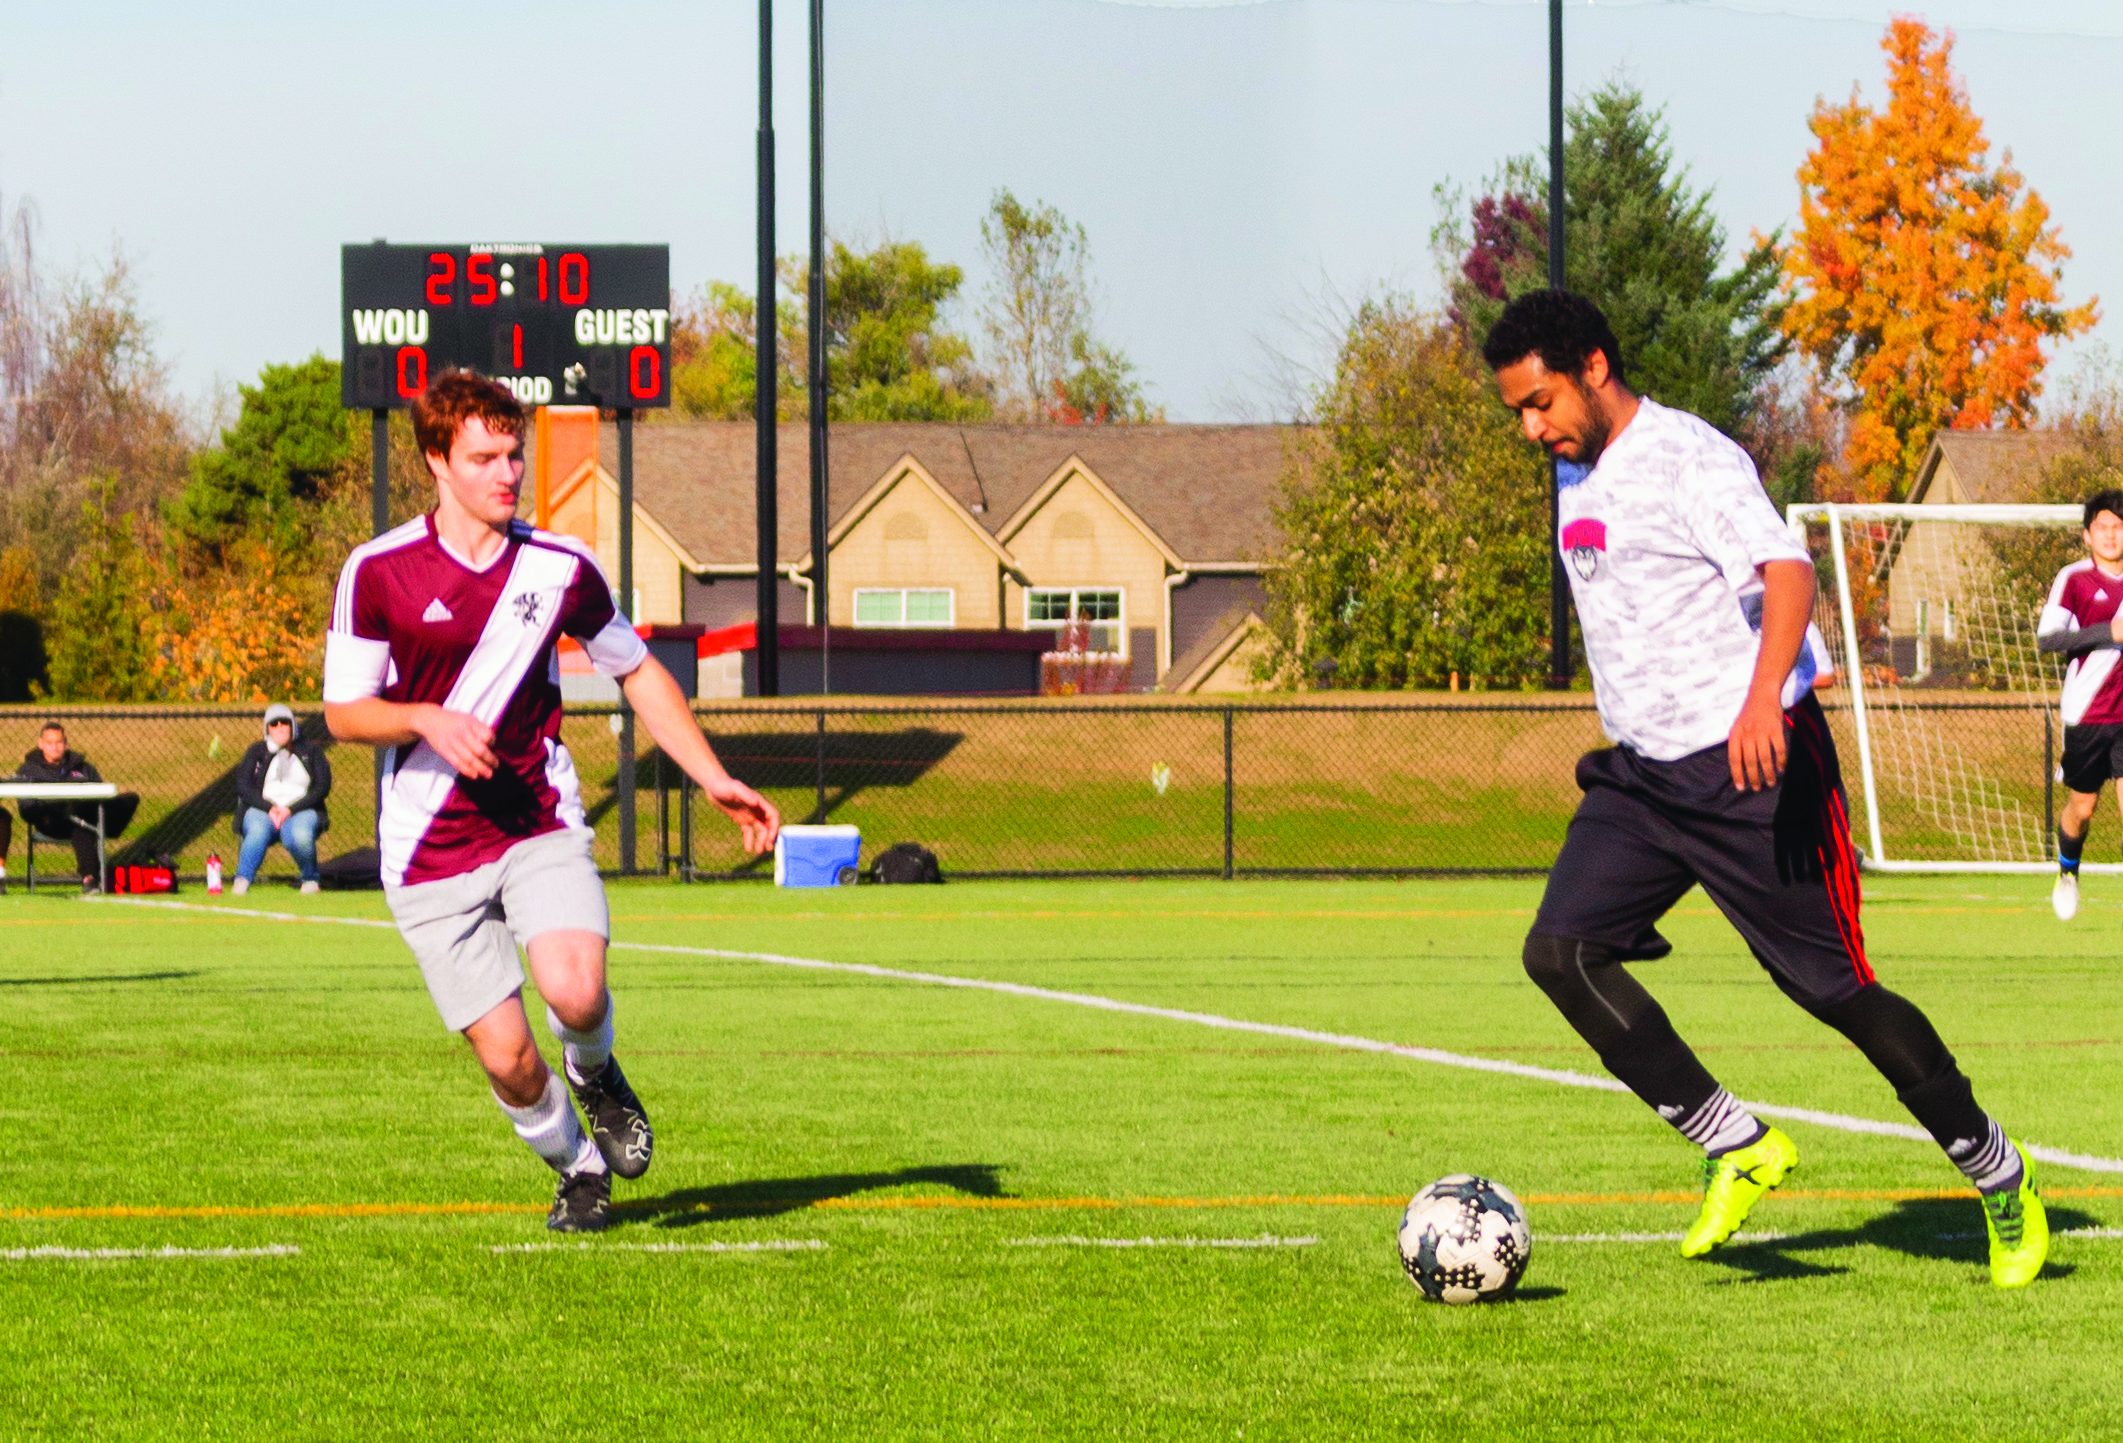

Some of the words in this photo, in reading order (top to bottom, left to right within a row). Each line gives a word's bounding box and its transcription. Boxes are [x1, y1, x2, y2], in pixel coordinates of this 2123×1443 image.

[426, 252, 589, 305] 25:10
[353, 308, 429, 345] WOU
[513, 323, 523, 369] 1
[575, 308, 669, 345] GUEST
[396, 345, 427, 399] 0
[629, 345, 660, 399] 0
